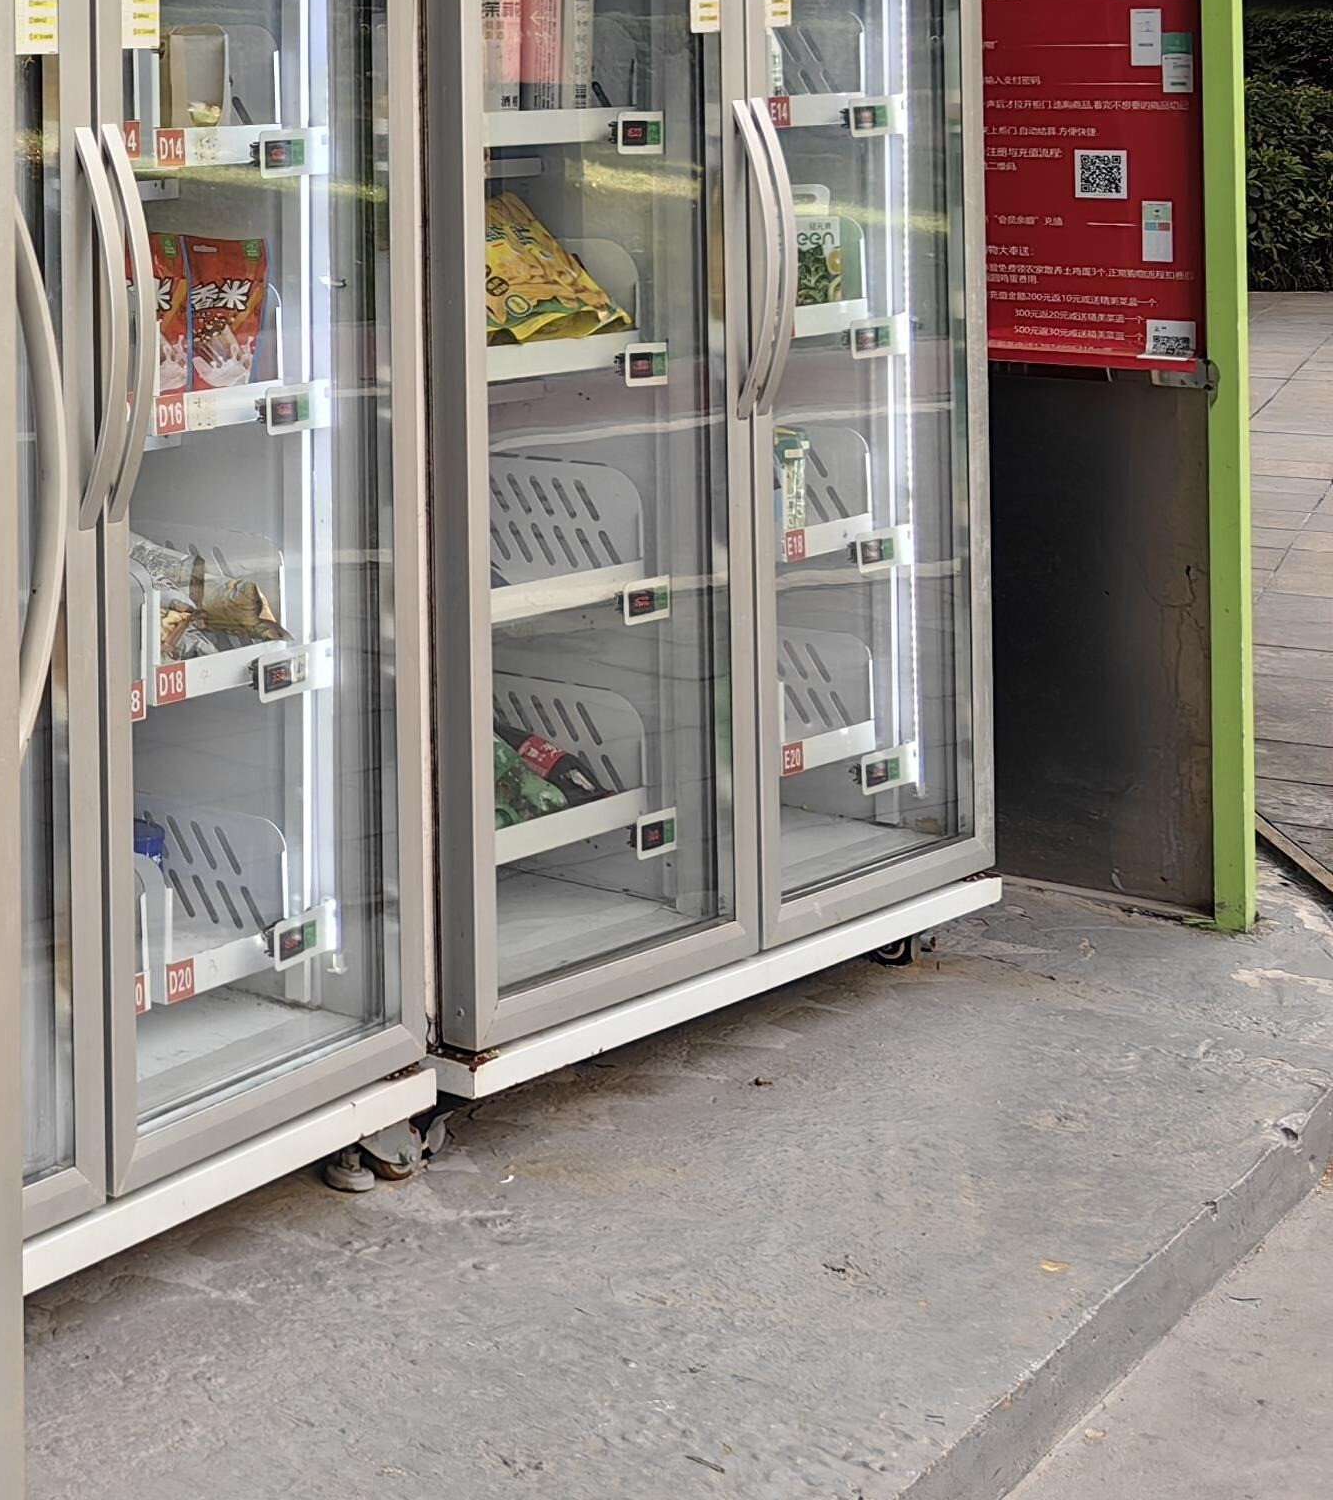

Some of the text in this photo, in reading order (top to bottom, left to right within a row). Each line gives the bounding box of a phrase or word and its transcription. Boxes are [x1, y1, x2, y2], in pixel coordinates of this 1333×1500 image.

[770, 102, 788, 122] E14
[159, 137, 183, 160] D14
[158, 402, 183, 427] D16
[787, 536, 803, 556] E18
[158, 670, 184, 697] D18
[784, 748, 800, 770] E20
[168, 969, 192, 994] D20
